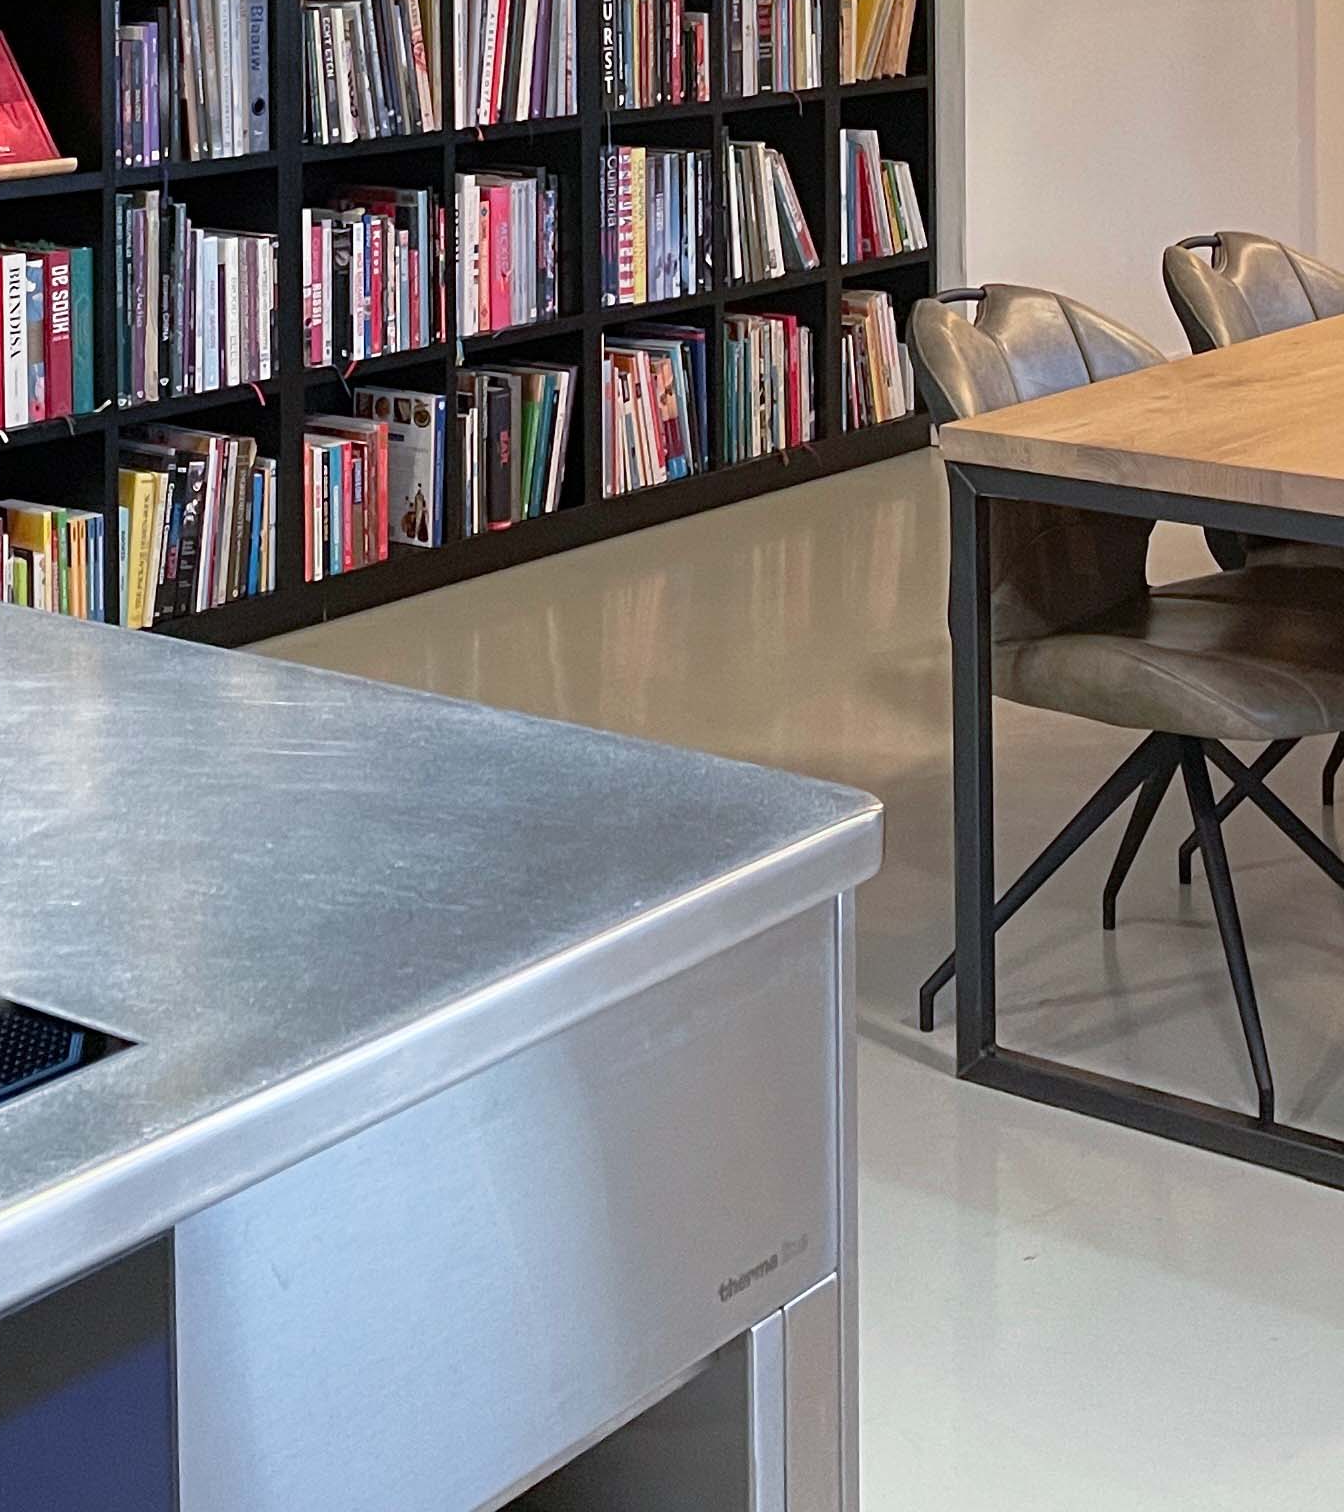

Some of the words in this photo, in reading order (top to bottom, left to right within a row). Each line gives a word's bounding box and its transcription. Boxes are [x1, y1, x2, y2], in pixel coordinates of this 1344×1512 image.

[250, 3, 266, 72] Blaauw
[606, 155, 617, 228] Culinaria
[9, 267, 22, 359] BRINDISA
